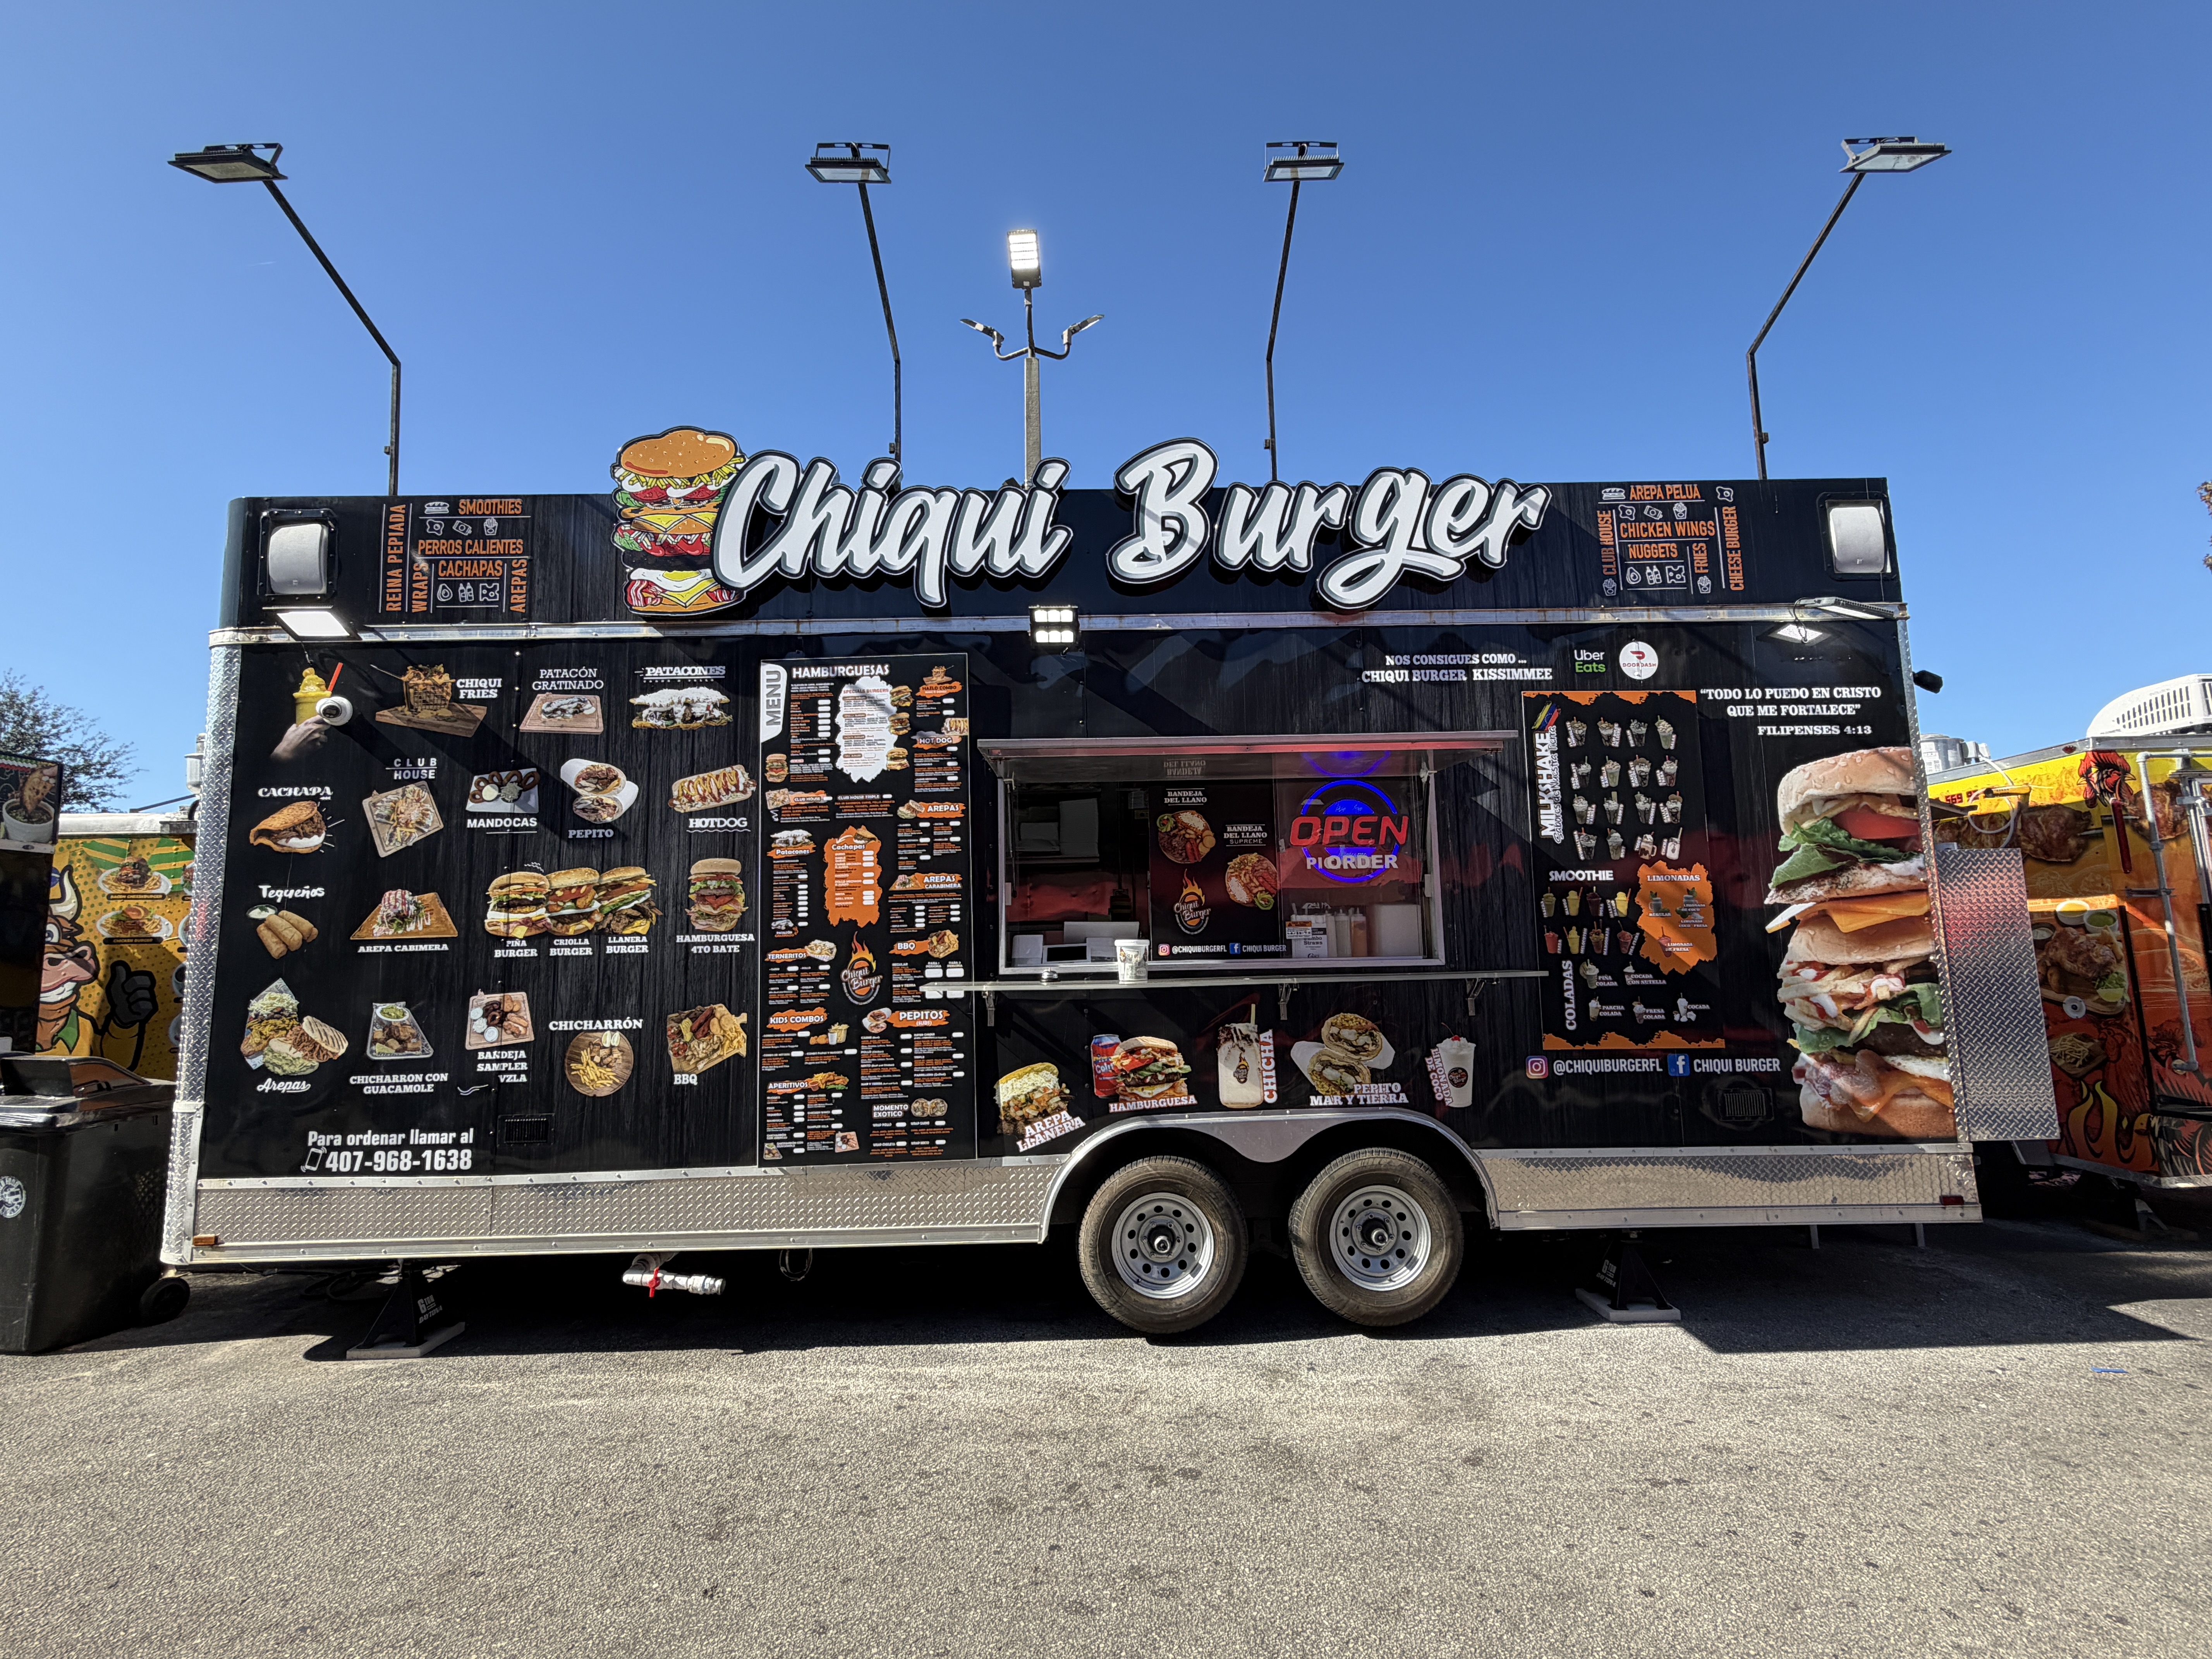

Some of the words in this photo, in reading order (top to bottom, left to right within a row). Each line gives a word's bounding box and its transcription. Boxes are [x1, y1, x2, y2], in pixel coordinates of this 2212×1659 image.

[1630, 484, 1664, 500] AREPA
[1665, 484, 1701, 499] PELUA
[458, 499, 522, 515] SMOOTHIES
[713, 451, 1071, 606] Chiqui
[1109, 438, 1551, 609] Burger
[1597, 510, 1614, 545] HOUSE
[1620, 521, 1672, 538] CHICKEN
[1674, 520, 1716, 537] WINGS
[1722, 506, 1740, 549] BURGER
[387, 505, 406, 563] PEPIADA
[418, 539, 462, 555] PERROS
[465, 539, 524, 554] CALIENTES
[1628, 543, 1678, 559] NUGGETS
[1601, 548, 1617, 575] CLUB
[1692, 543, 1709, 573] FRIES
[438, 560, 503, 577] CACHAPAS
[1727, 550, 1744, 591] CHEESE
[386, 568, 402, 611] REINA
[412, 563, 429, 613] WRAPS
[510, 559, 527, 613] AREPAS
[1386, 655, 1410, 666] NOS
[1412, 654, 1480, 665] CONSIGUES
[1482, 653, 1516, 664] COMO
[1574, 649, 1605, 661] Uber
[539, 666, 598, 678] PATACÓN
[645, 666, 726, 676] PATACONES
[793, 665, 889, 678] HAMBURGUESAS
[1575, 661, 1606, 673] Eats
[1361, 670, 1409, 683] CHIQUI
[1412, 669, 1467, 682] BURGER
[1472, 668, 1553, 681] KISSIMMEE
[456, 678, 502, 689] CHIQUI
[532, 680, 604, 690] GRATINADO
[459, 689, 498, 699] FRIES
[766, 670, 781, 726] MENU
[1745, 688, 1762, 699] LO
[1764, 688, 1809, 699] PUEDO
[1812, 688, 1830, 699] EN
[1833, 686, 1881, 699] CRISTO
[1726, 705, 1754, 717] QUE
[1757, 705, 1778, 716] ME
[1757, 725, 1840, 735] FILIPENSES
[1844, 725, 1872, 735] 4:13
[1548, 725, 1557, 750] Tierra
[394, 757, 437, 767] CLUB
[394, 769, 436, 780] HOUSE
[1550, 753, 1560, 789] Nuestra
[1535, 733, 1555, 836] MILKSHAKE
[258, 786, 333, 798] CACHAPA
[1552, 790, 1561, 802] de
[467, 817, 537, 828] MANDOCAS
[688, 817, 748, 828] HOTDOG
[1553, 804, 1564, 844] Sabores
[568, 829, 614, 839] PEPITO
[1290, 816, 1409, 846] OPEN
[1326, 854, 1398, 869] ORDER
[1549, 870, 1614, 881] SMOOTHIE
[258, 884, 325, 903] Tequeños
[506, 939, 527, 948] PIÑA
[553, 938, 590, 946] CRIOLLA
[608, 936, 648, 944] LLANERA
[676, 933, 755, 943] HAMBURGUESA
[357, 945, 393, 953] AREPA
[394, 943, 449, 952] CABIMERA
[494, 948, 538, 958] BURGER
[550, 947, 592, 957] BURGER
[606, 945, 649, 954] BURGER
[691, 945, 710, 954] 4TO
[713, 945, 740, 953] BATE
[1172, 945, 1227, 953] @CHIQUIBURGERFL
[1562, 959, 1577, 1031] COLADAS
[770, 1016, 788, 1024] KIDS
[790, 1015, 825, 1023] COMBOS
[899, 1010, 944, 1021] PEPITOS
[549, 1017, 643, 1032] CHICHARRÓN
[477, 1050, 527, 1060] BANDEJA
[477, 1061, 528, 1072] SAMPLER
[1259, 1029, 1277, 1104] CHICHA
[1553, 1058, 1663, 1075] @CHIQUIBURGERFL
[1693, 1058, 1732, 1073] CHIQUI
[1736, 1058, 1781, 1072] BURGER
[349, 1074, 424, 1085] CHICHARRON
[425, 1073, 448, 1082] CON
[498, 1073, 528, 1083] VZLA
[673, 1073, 698, 1086] BBQ
[1425, 1057, 1434, 1072] DE
[1431, 1072, 1443, 1101] COCO
[1431, 1048, 1453, 1106] LIMONADA
[256, 1078, 311, 1093] Arepas
[363, 1084, 434, 1094] GUACAMOLE
[1353, 1083, 1401, 1095] PEPITO
[1109, 1096, 1197, 1113] HAMBURGUESA
[1310, 1095, 1343, 1106] MAR
[1345, 1094, 1355, 1105] Y
[1357, 1093, 1409, 1104] TIERRA
[1024, 1111, 1073, 1138] AREPA
[307, 1131, 342, 1147] Para
[347, 1130, 405, 1146] ordenar
[409, 1128, 456, 1146] llamar
[460, 1128, 474, 1144] al
[1017, 1117, 1085, 1152] LLANERA
[325, 1149, 472, 1172] 407-968-1638
[417, 1298, 427, 1314] 6
